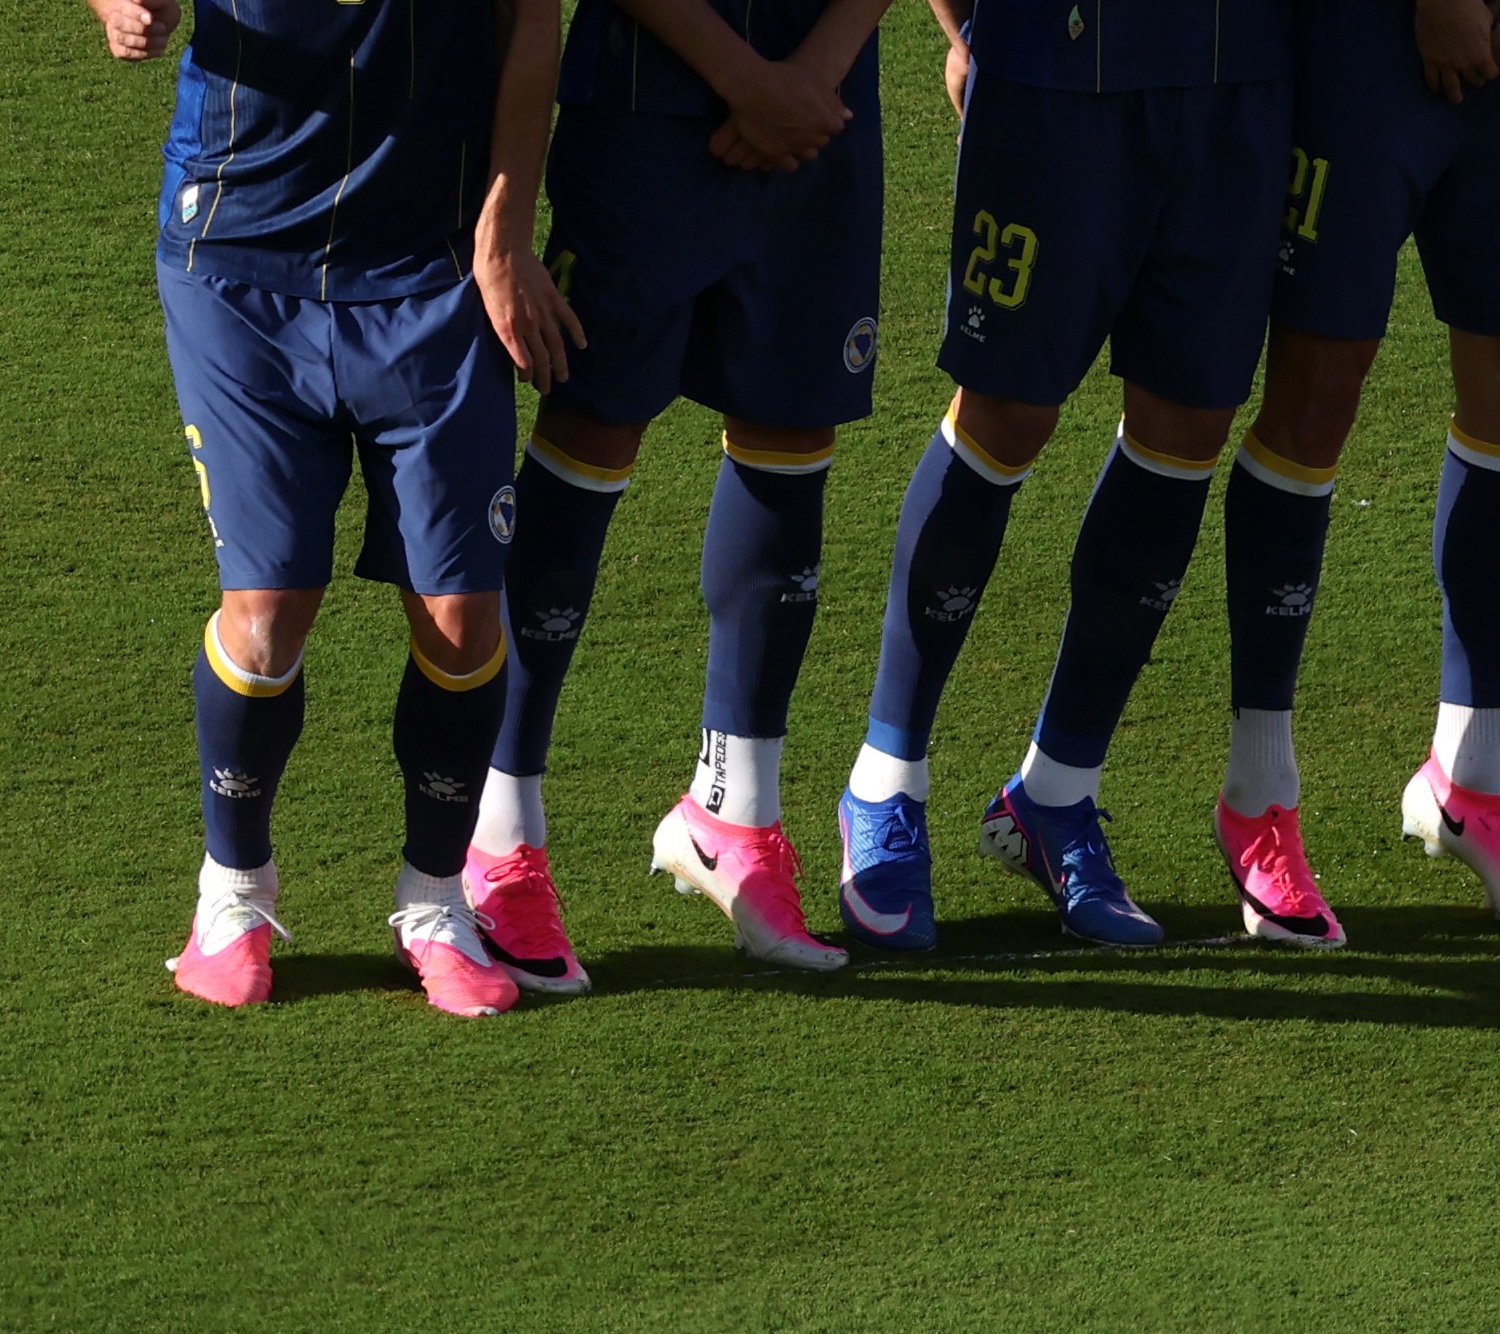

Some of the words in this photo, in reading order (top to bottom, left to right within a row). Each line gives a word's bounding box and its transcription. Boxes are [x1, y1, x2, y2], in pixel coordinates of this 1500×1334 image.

[963, 209, 1039, 311] 23
[960, 324, 986, 343] KELME
[209, 780, 261, 799] KELME
[419, 783, 468, 802] KELME
